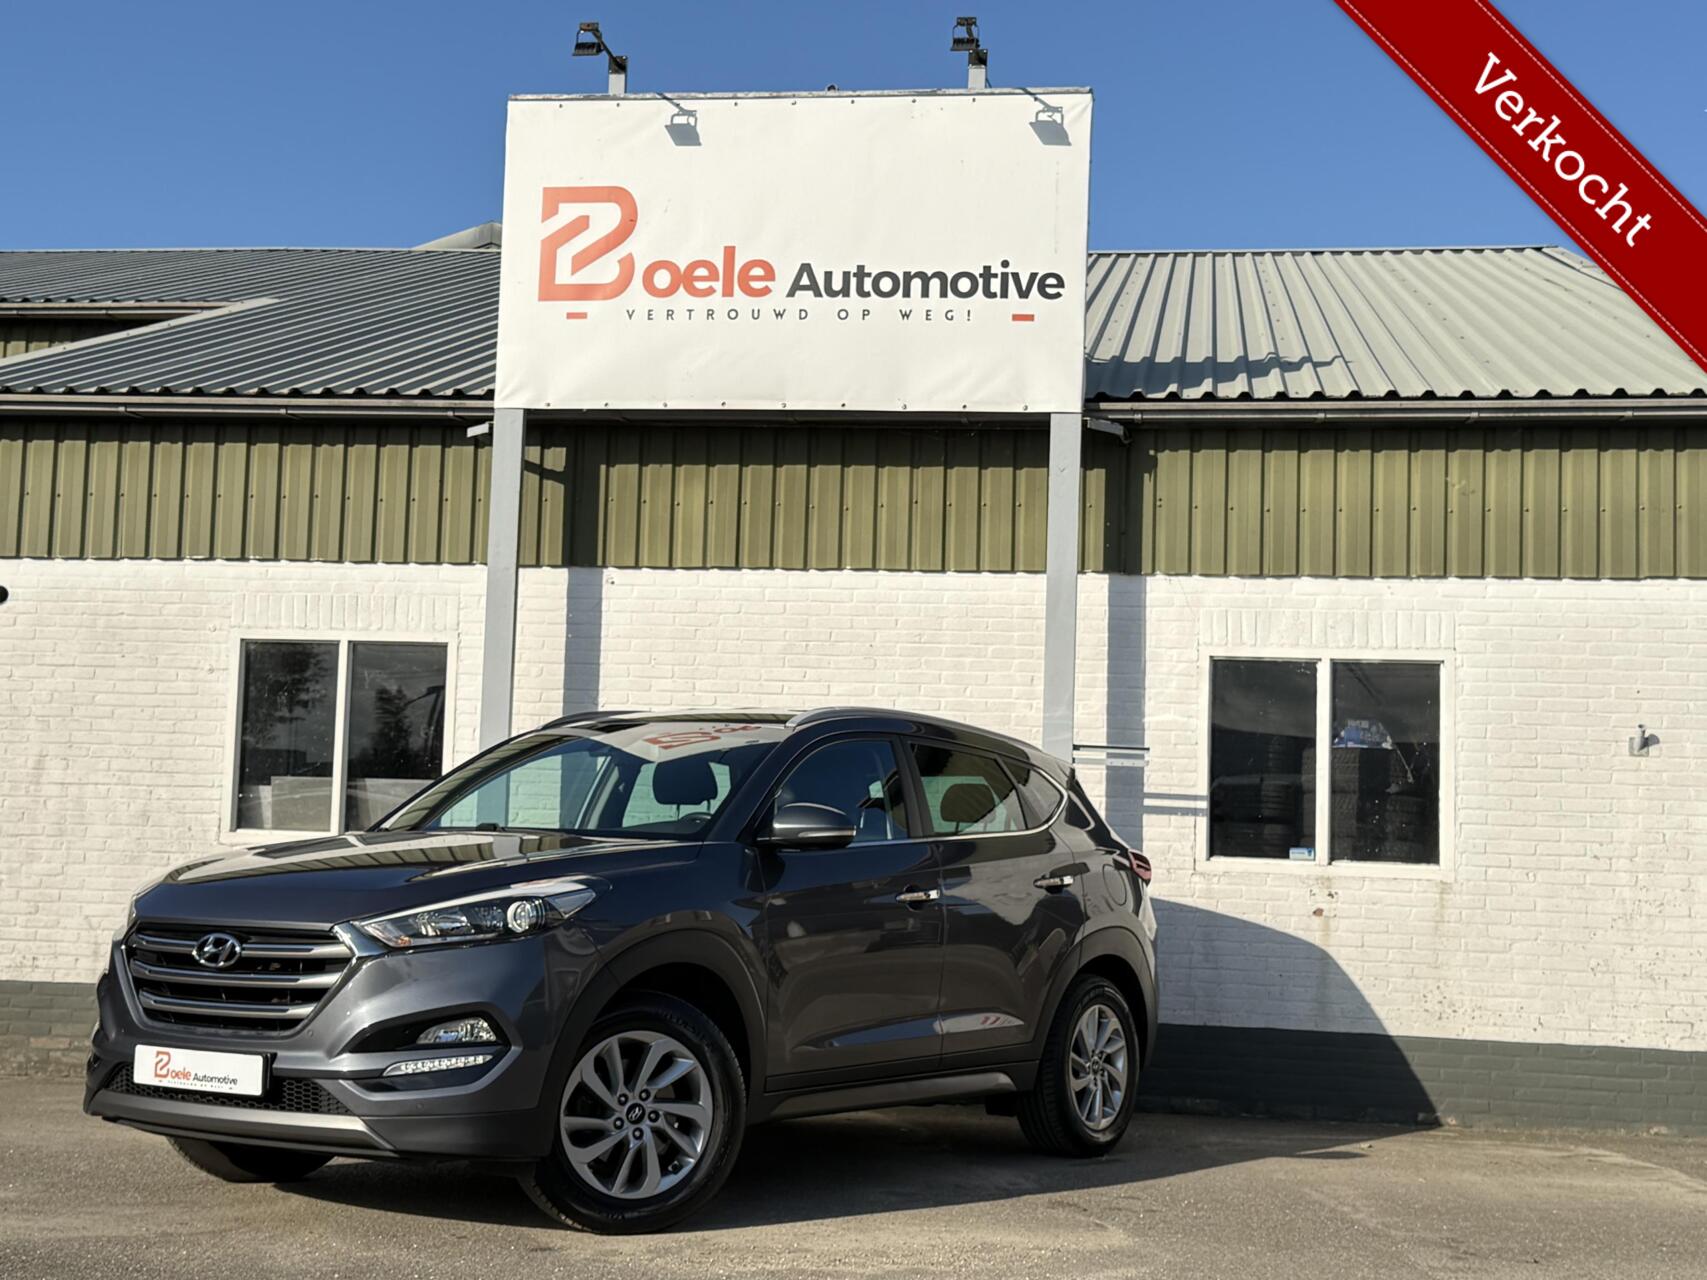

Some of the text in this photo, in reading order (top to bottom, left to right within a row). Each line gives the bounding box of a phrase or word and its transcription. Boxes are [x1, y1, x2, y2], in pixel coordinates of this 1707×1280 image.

[538, 186, 1065, 301] Boele Automotive
[627, 309, 972, 322] VERTROUWD OP WEG!
[192, 1072, 238, 1086] Automotive
